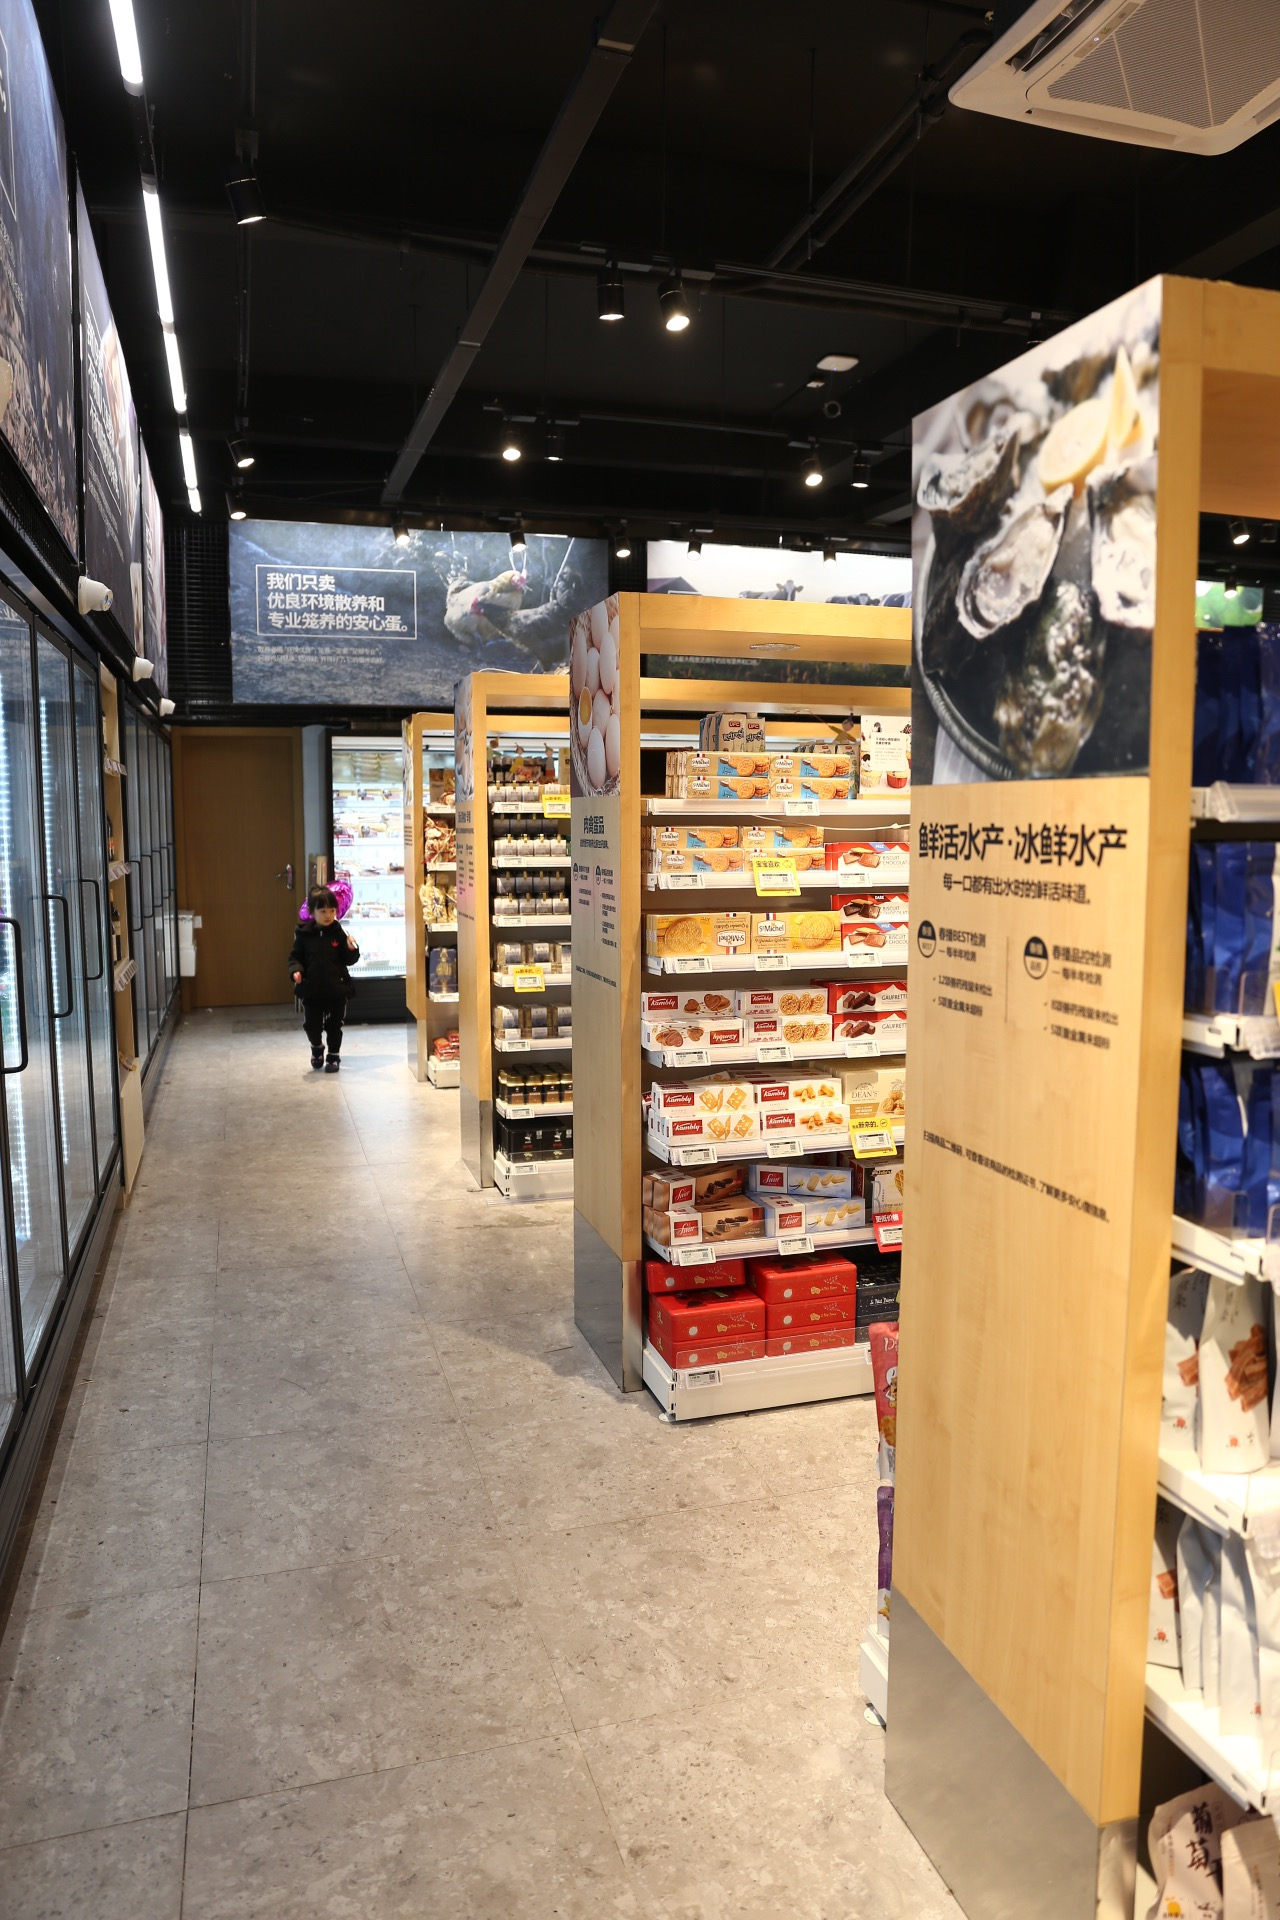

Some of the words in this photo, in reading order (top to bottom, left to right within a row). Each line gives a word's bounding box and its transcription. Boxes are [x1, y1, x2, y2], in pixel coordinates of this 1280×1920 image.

[266, 572, 336, 592] 我们只卖
[267, 592, 385, 612] 优良环境散养和
[268, 611, 408, 632] 专业笼养的安心蛋。
[765, 924, 785, 932] Michel
[650, 996, 676, 1007] Kambly
[751, 994, 772, 1002] Kambly
[755, 1022, 775, 1030] Kambly
[762, 1089, 787, 1098] Kambly
[851, 1091, 878, 1099] DEAN'S
[664, 1094, 692, 1104] Kambly
[767, 1116, 793, 1125] Kambly
[674, 1122, 700, 1131] Kambly
